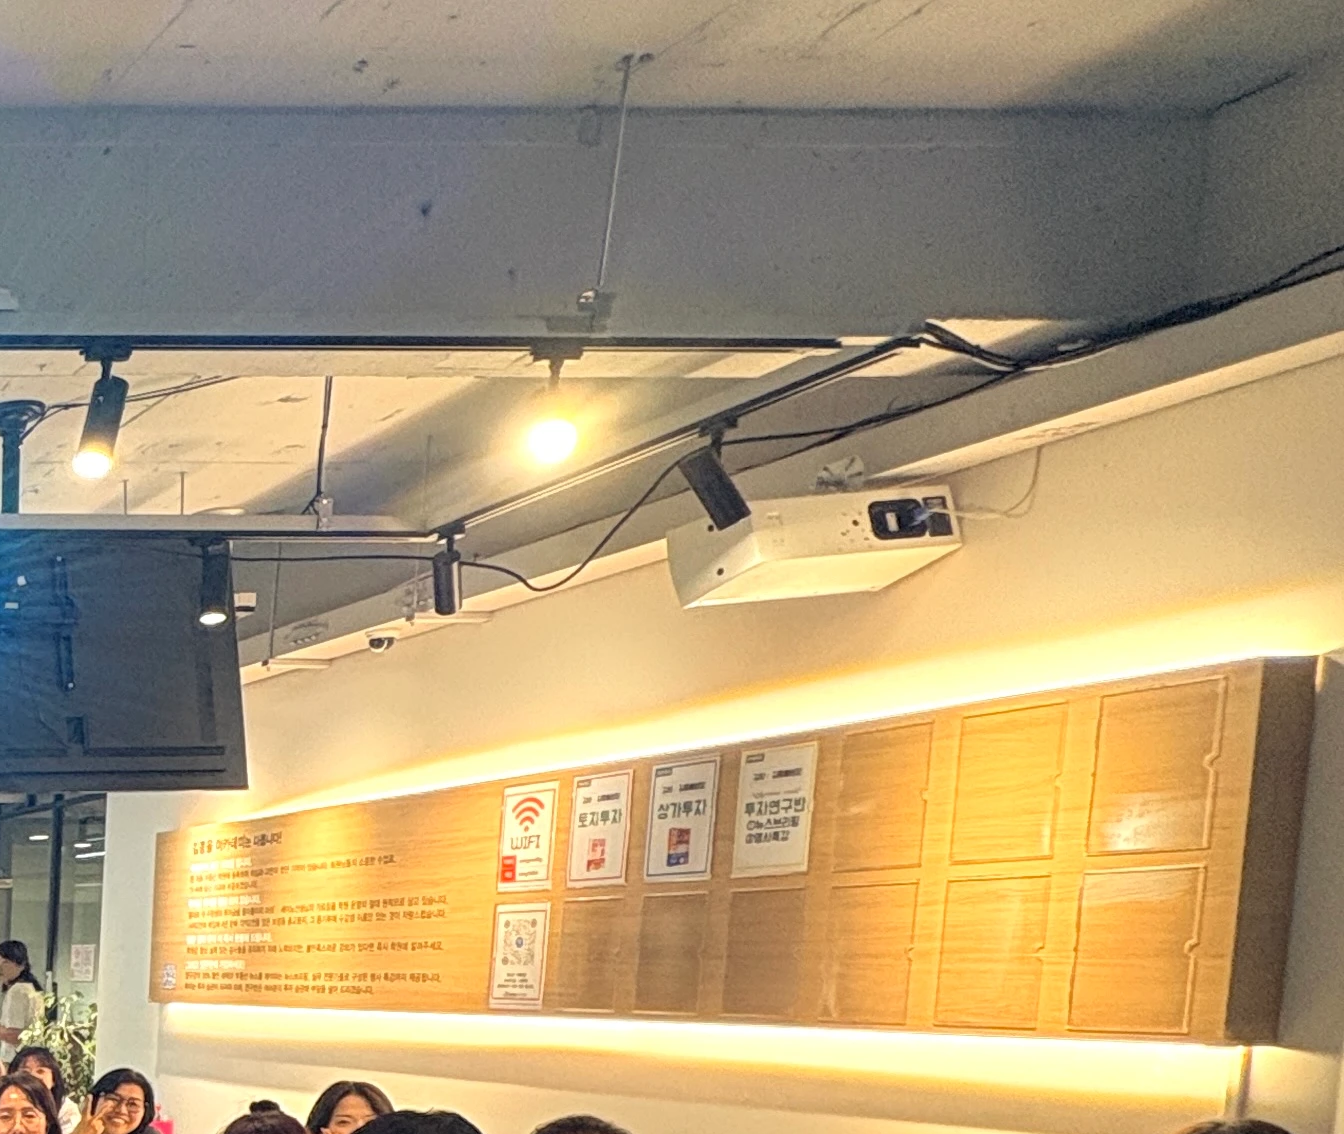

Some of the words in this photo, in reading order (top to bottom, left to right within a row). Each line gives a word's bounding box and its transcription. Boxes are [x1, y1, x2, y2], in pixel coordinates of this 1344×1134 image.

[657, 799, 708, 820] 상가투자
[744, 797, 806, 817] 투자연구반
[578, 808, 623, 828] 토지투자
[511, 835, 540, 850] WIFI
